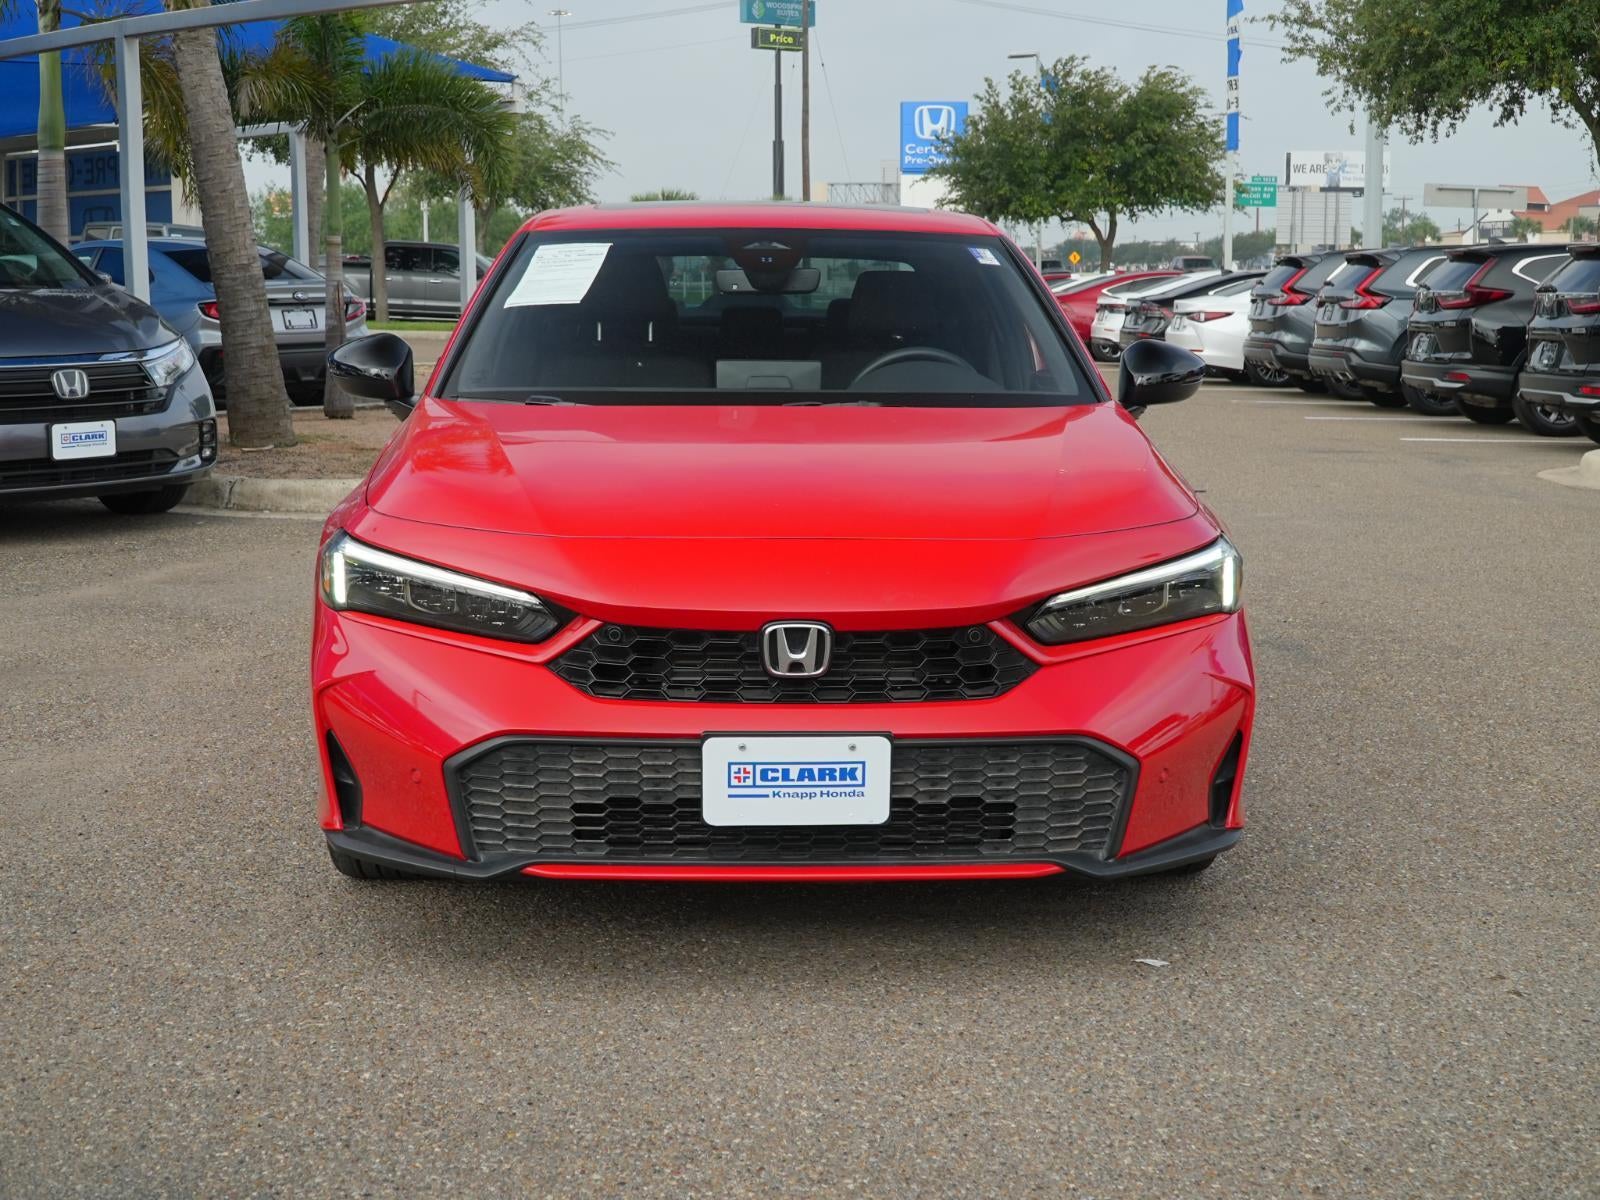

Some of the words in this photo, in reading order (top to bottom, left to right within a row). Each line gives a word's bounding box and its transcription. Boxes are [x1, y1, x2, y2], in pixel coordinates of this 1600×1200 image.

[770, 33, 794, 44] Price
[1293, 163, 1307, 174] WE
[1309, 163, 1328, 174] ARE
[72, 433, 105, 441] CLARK
[759, 767, 859, 782] CLARK
[771, 790, 817, 800] Knapp
[819, 789, 865, 798] Honda
